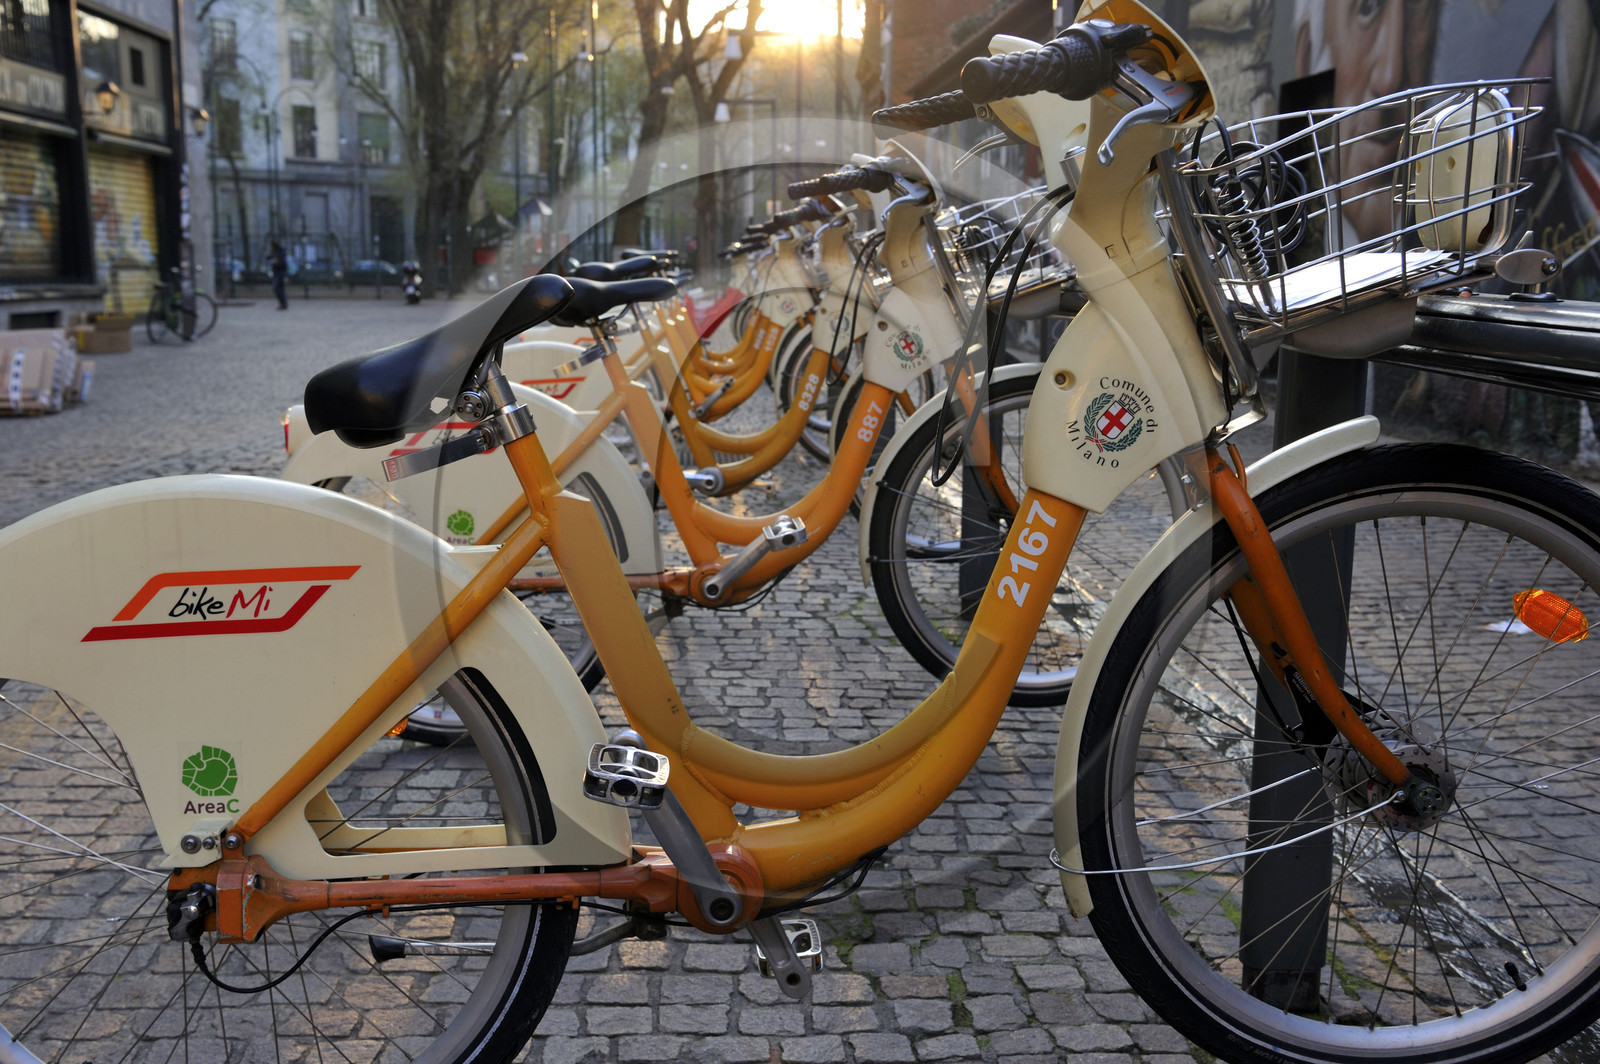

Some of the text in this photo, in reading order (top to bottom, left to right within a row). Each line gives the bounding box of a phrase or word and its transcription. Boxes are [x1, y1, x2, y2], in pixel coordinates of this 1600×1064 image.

[799, 374, 820, 411] 8328
[1100, 376, 1159, 433] Comune di
[858, 401, 883, 442] 887
[1066, 420, 1120, 469] Milano
[997, 499, 1058, 608] 2167
